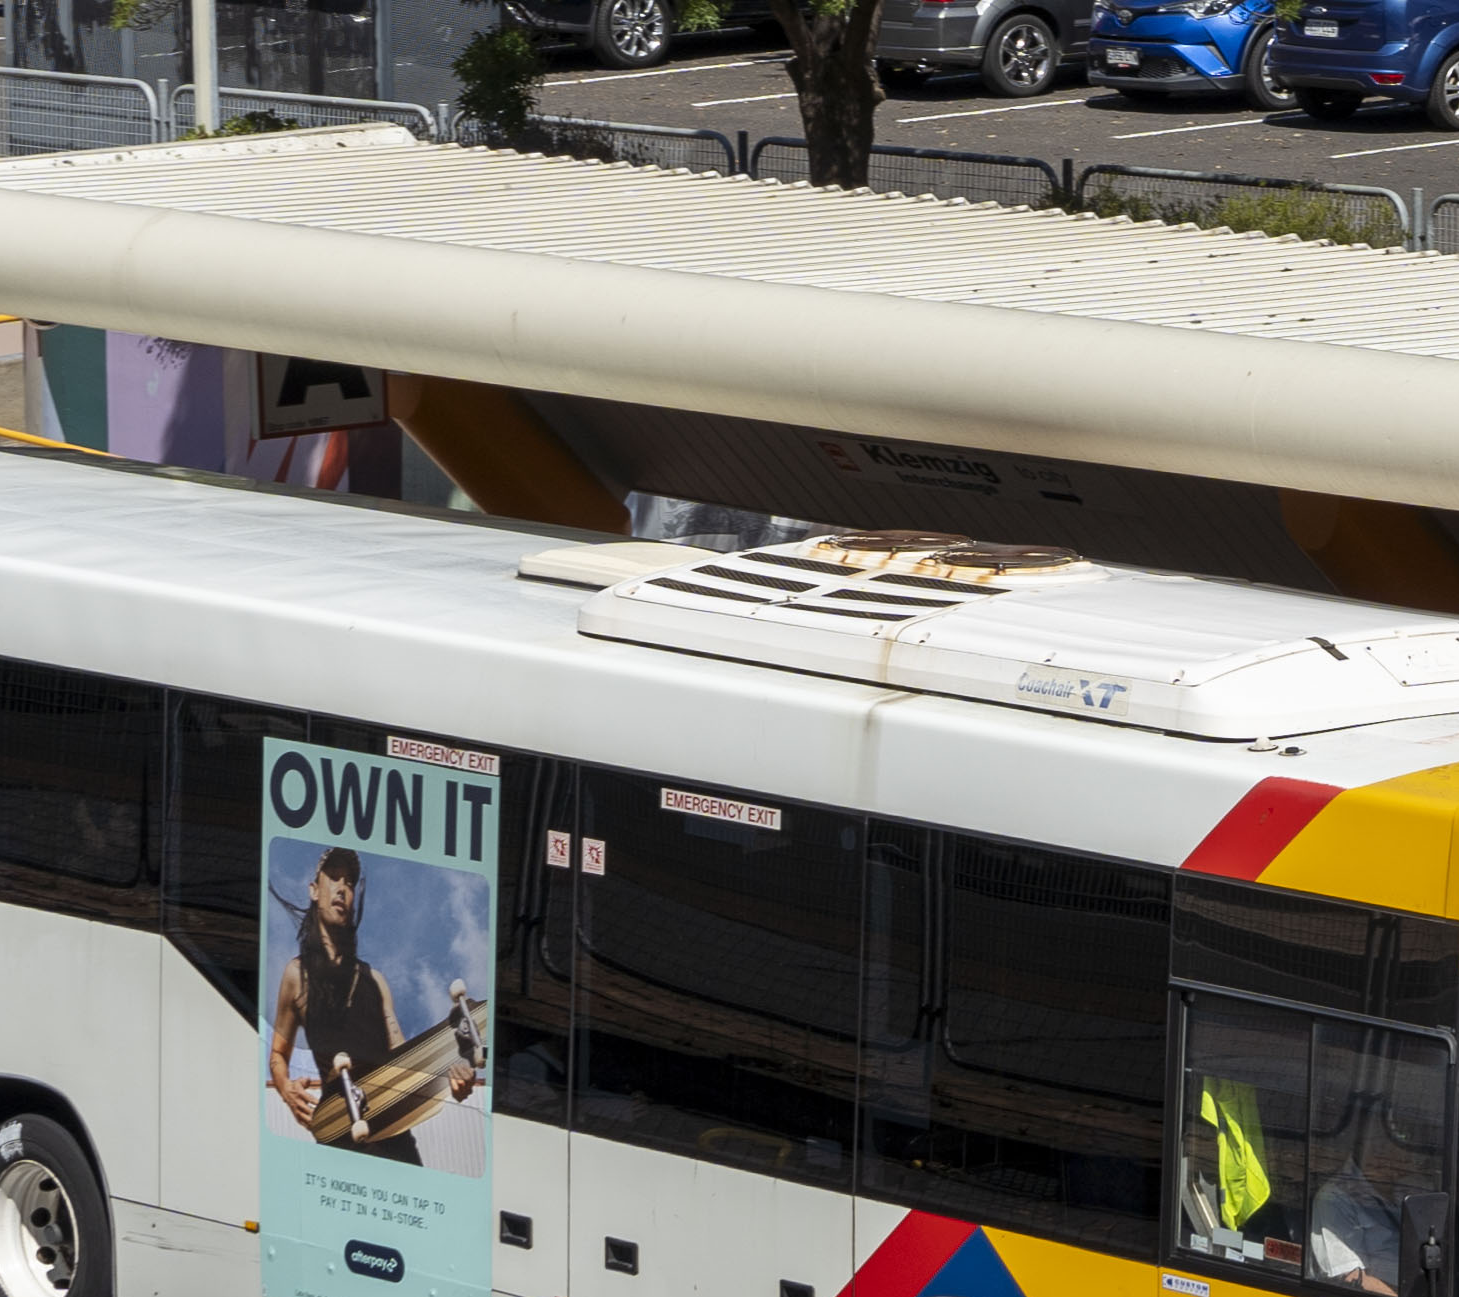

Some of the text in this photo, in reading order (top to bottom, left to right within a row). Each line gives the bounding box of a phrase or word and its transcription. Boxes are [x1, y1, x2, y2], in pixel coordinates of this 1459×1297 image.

[859, 442, 1002, 484] Klemzig
[391, 739, 496, 772] EMERGENCY EXIT
[270, 751, 493, 862] OWN IT
[665, 791, 777, 826] EMERGENCY EXIT
[305, 1173, 445, 1215] IT'S KNOWING YOU CAN TAP TO
[320, 1195, 336, 1208] PAY
[341, 1200, 352, 1212] IT
[356, 1203, 368, 1216] IN
[371, 1207, 378, 1217] 4
[351, 1250, 387, 1271] afterpay
